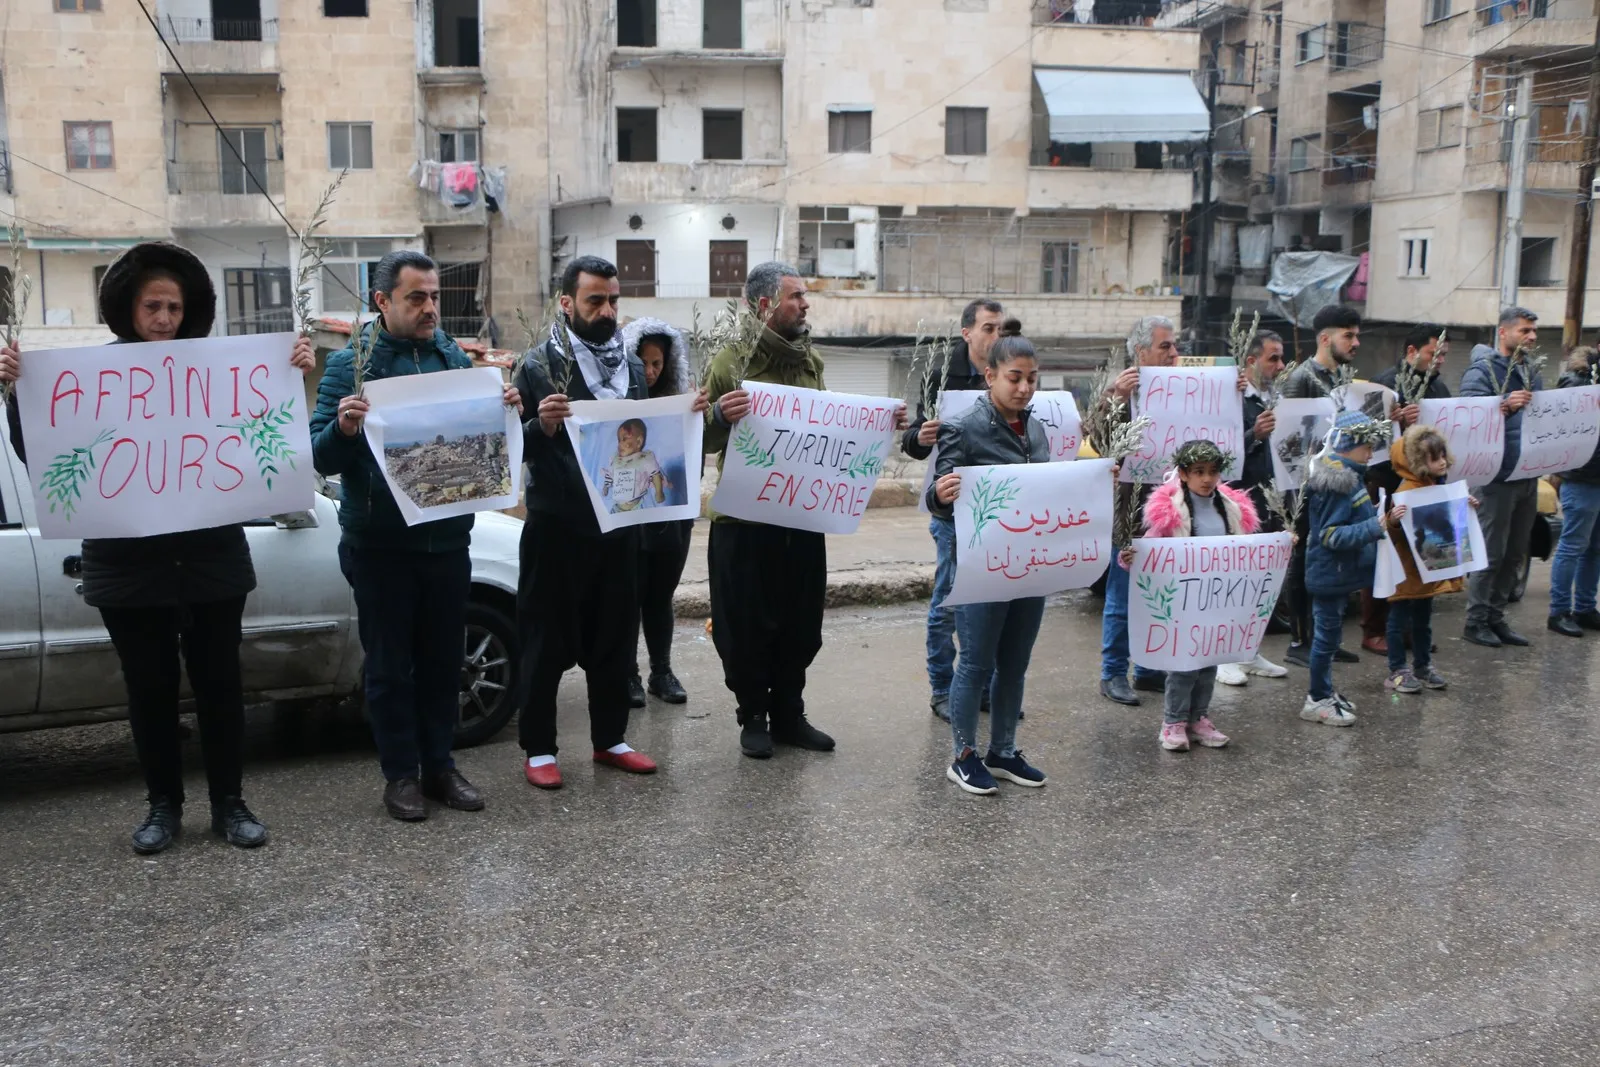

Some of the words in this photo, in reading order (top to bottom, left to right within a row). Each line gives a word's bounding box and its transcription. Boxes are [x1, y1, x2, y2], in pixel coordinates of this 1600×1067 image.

[51, 356, 211, 427] AFRÎN
[230, 364, 269, 419] IS
[750, 390, 786, 417] NON
[767, 429, 856, 471] TURQUE
[1162, 425, 1175, 456] A
[99, 434, 244, 499] OURS
[757, 472, 804, 507] EN
[803, 479, 867, 516] SYRIE
[998, 508, 1090, 536] عفرين
[986, 546, 1011, 572] لنا
[1081, 539, 1098, 562] لنا
